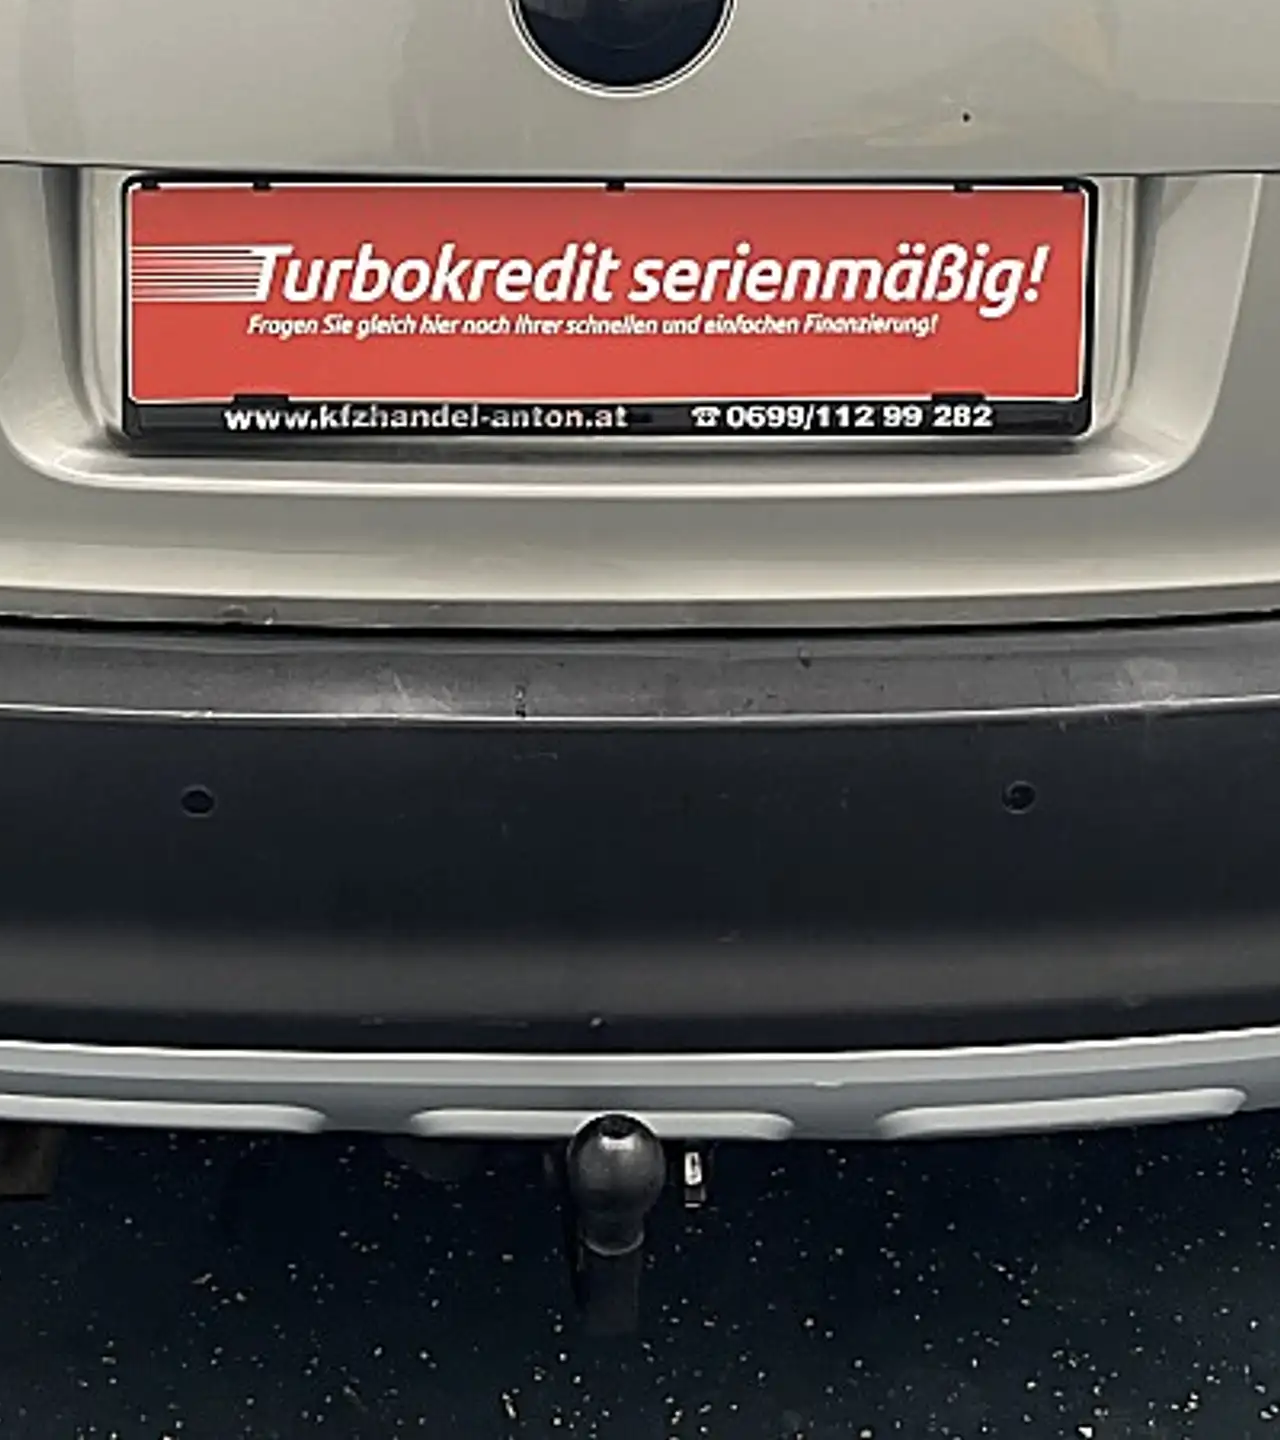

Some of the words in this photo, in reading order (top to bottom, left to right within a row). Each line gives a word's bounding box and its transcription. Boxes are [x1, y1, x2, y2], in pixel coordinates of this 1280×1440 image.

[250, 240, 622, 303] Turbokredit
[627, 241, 1051, 319] serienmäßig!
[247, 313, 318, 341] Fragen
[321, 314, 353, 335] Sie
[356, 313, 417, 340] gleich
[419, 314, 458, 335] hier
[513, 314, 564, 335] Ihrer
[566, 313, 658, 336] schnellen
[662, 314, 700, 335] und
[703, 313, 801, 336] einfachen
[803, 313, 940, 338] Finanzierung!
[223, 404, 629, 431] www.kfzhandel-anton.at
[726, 405, 875, 430] 0699/112
[883, 405, 923, 428] 99
[932, 405, 994, 428] 282
